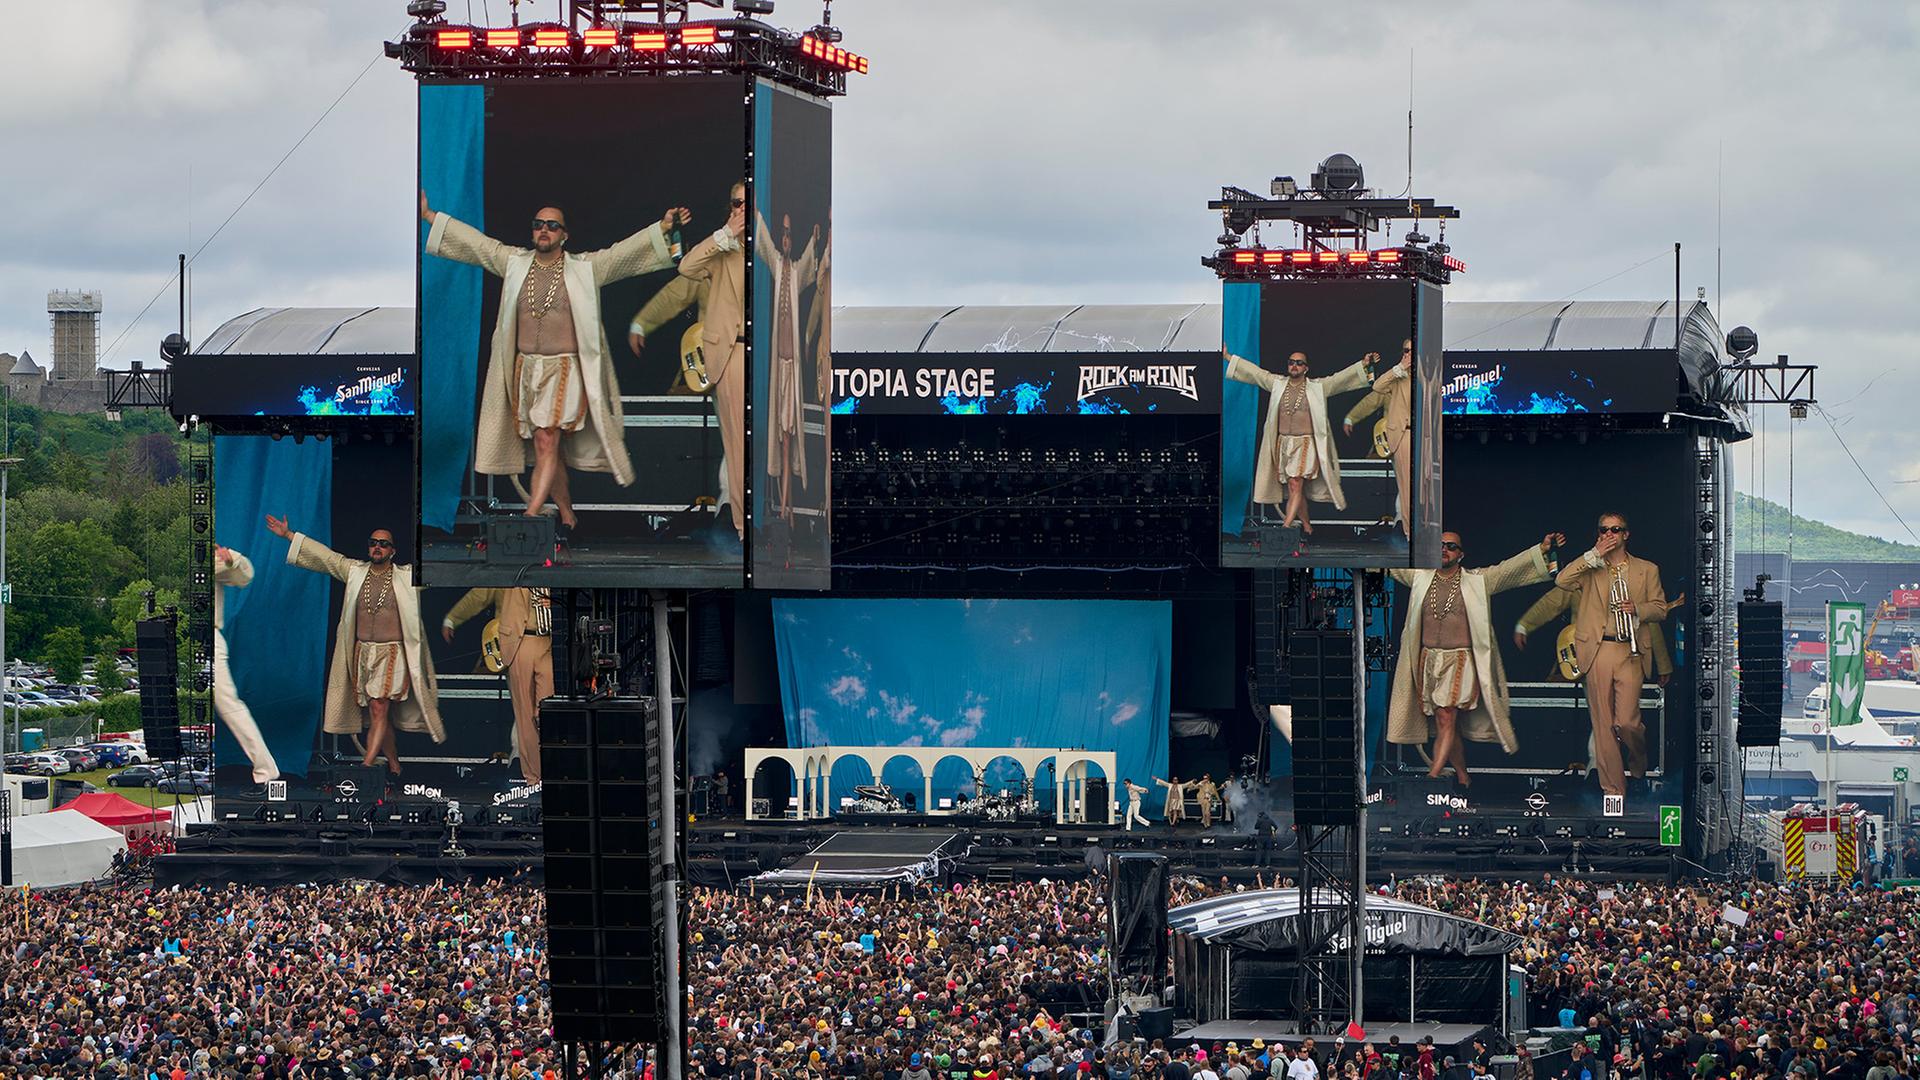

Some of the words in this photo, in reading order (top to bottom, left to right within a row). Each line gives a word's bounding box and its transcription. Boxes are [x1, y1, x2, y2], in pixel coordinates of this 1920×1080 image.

[915, 368, 995, 398] STAGE
[1077, 365, 1129, 401] ROCK
[1129, 369, 1146, 383] AM
[1147, 365, 1199, 401] RING
[1441, 364, 1500, 397] anMiguel
[269, 782, 286, 799] Bild
[403, 784, 442, 799] SIMON
[1426, 794, 1467, 809] SIMON
[1605, 796, 1622, 814] Bild
